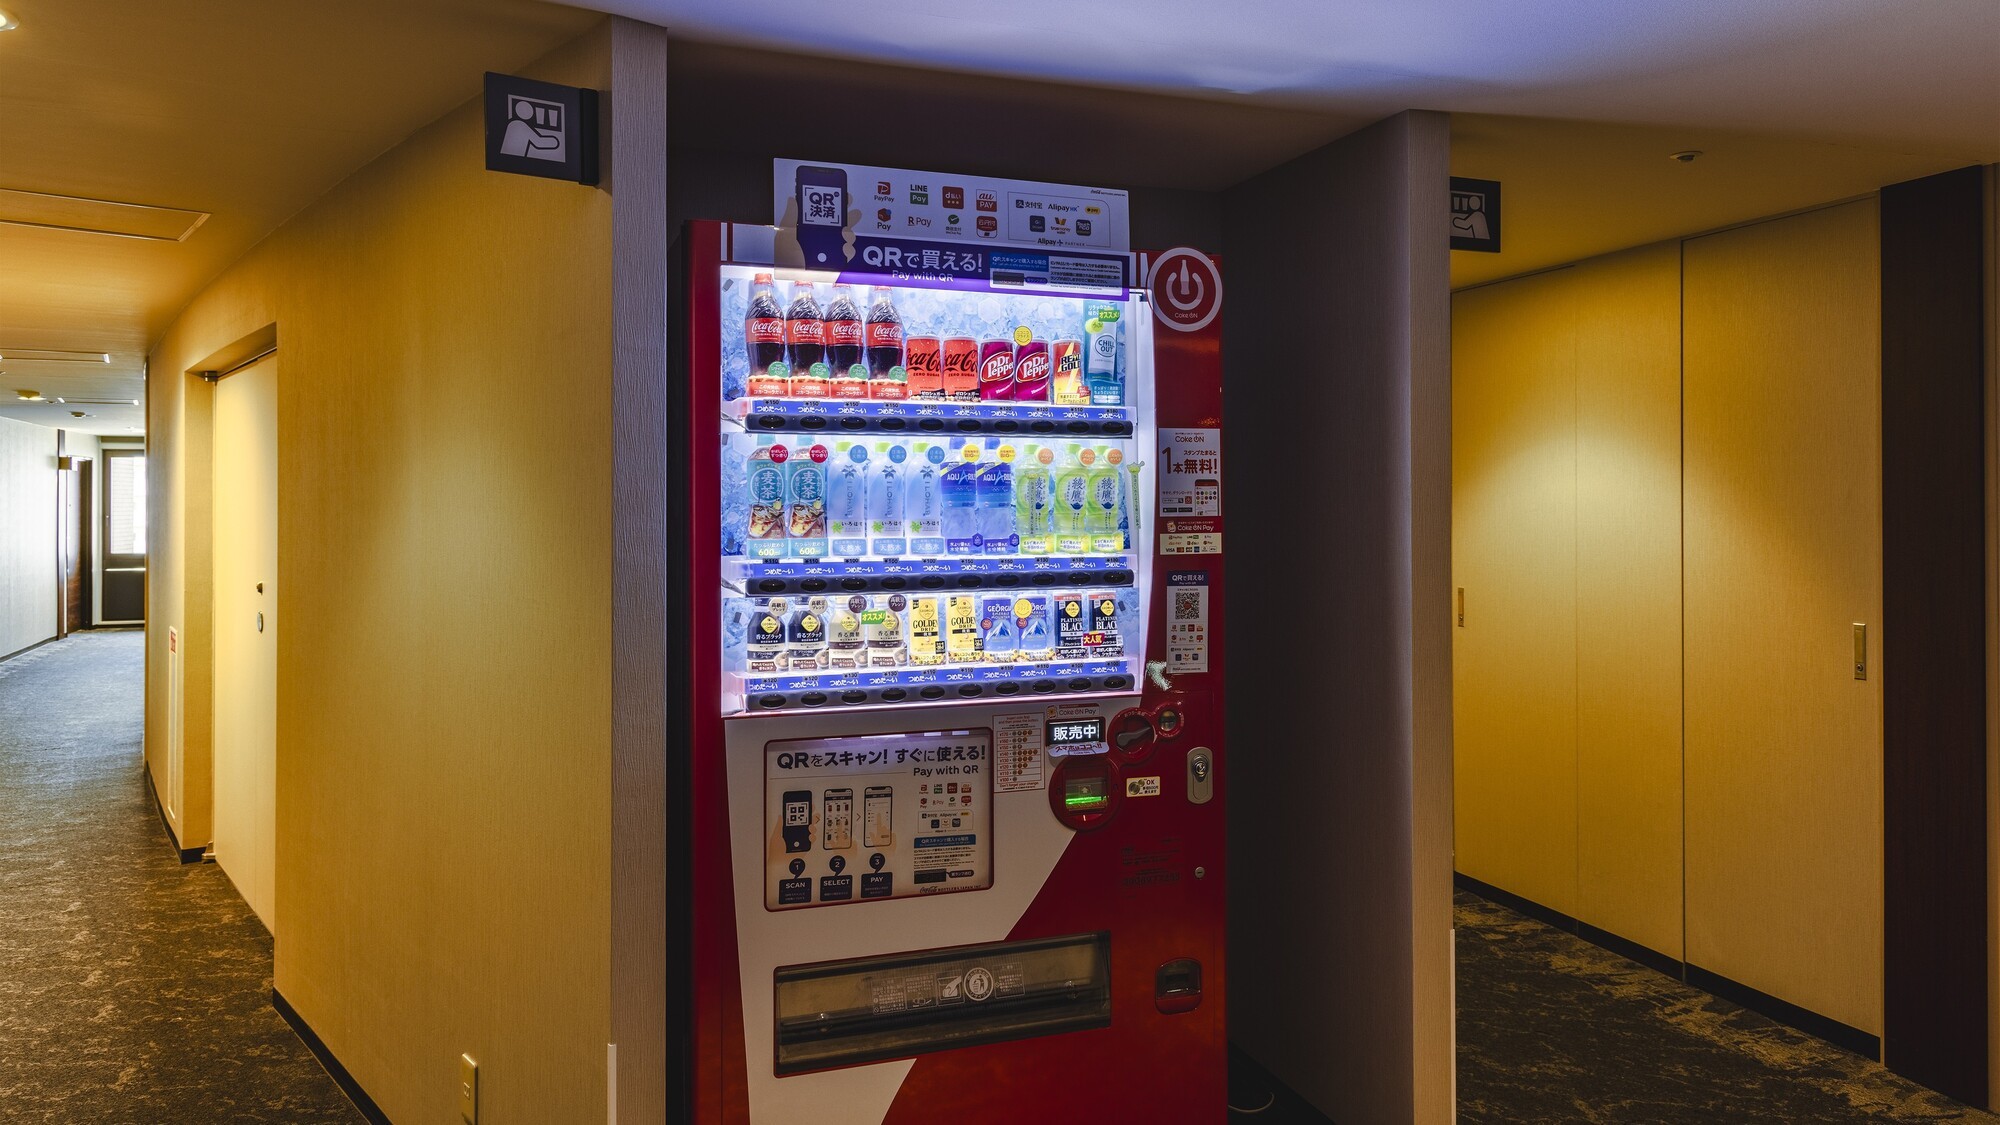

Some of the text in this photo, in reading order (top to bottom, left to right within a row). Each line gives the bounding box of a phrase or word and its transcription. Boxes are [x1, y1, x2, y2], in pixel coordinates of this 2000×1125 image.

[910, 184, 928, 192] LINE
[809, 192, 835, 206] QR
[874, 194, 894, 203] PayPay
[810, 205, 835, 219] 決済
[877, 222, 892, 231] Pay
[916, 217, 932, 227] Pay
[862, 246, 982, 273] QRで買える!
[892, 270, 954, 282] Pay with QR
[997, 356, 1008, 366] Dr
[1032, 356, 1045, 366] Dr
[1162, 447, 1218, 474] 1本無料!
[761, 471, 776, 499] 麦茶
[802, 471, 816, 499] 麦茶
[1084, 635, 1102, 643] 大人気
[1054, 725, 1097, 741] 販売中
[1056, 743, 1102, 752] スマホはココへ!!
[777, 746, 986, 769] QRをスキャン! すぐに使える!
[913, 765, 979, 776] Pay with QR
